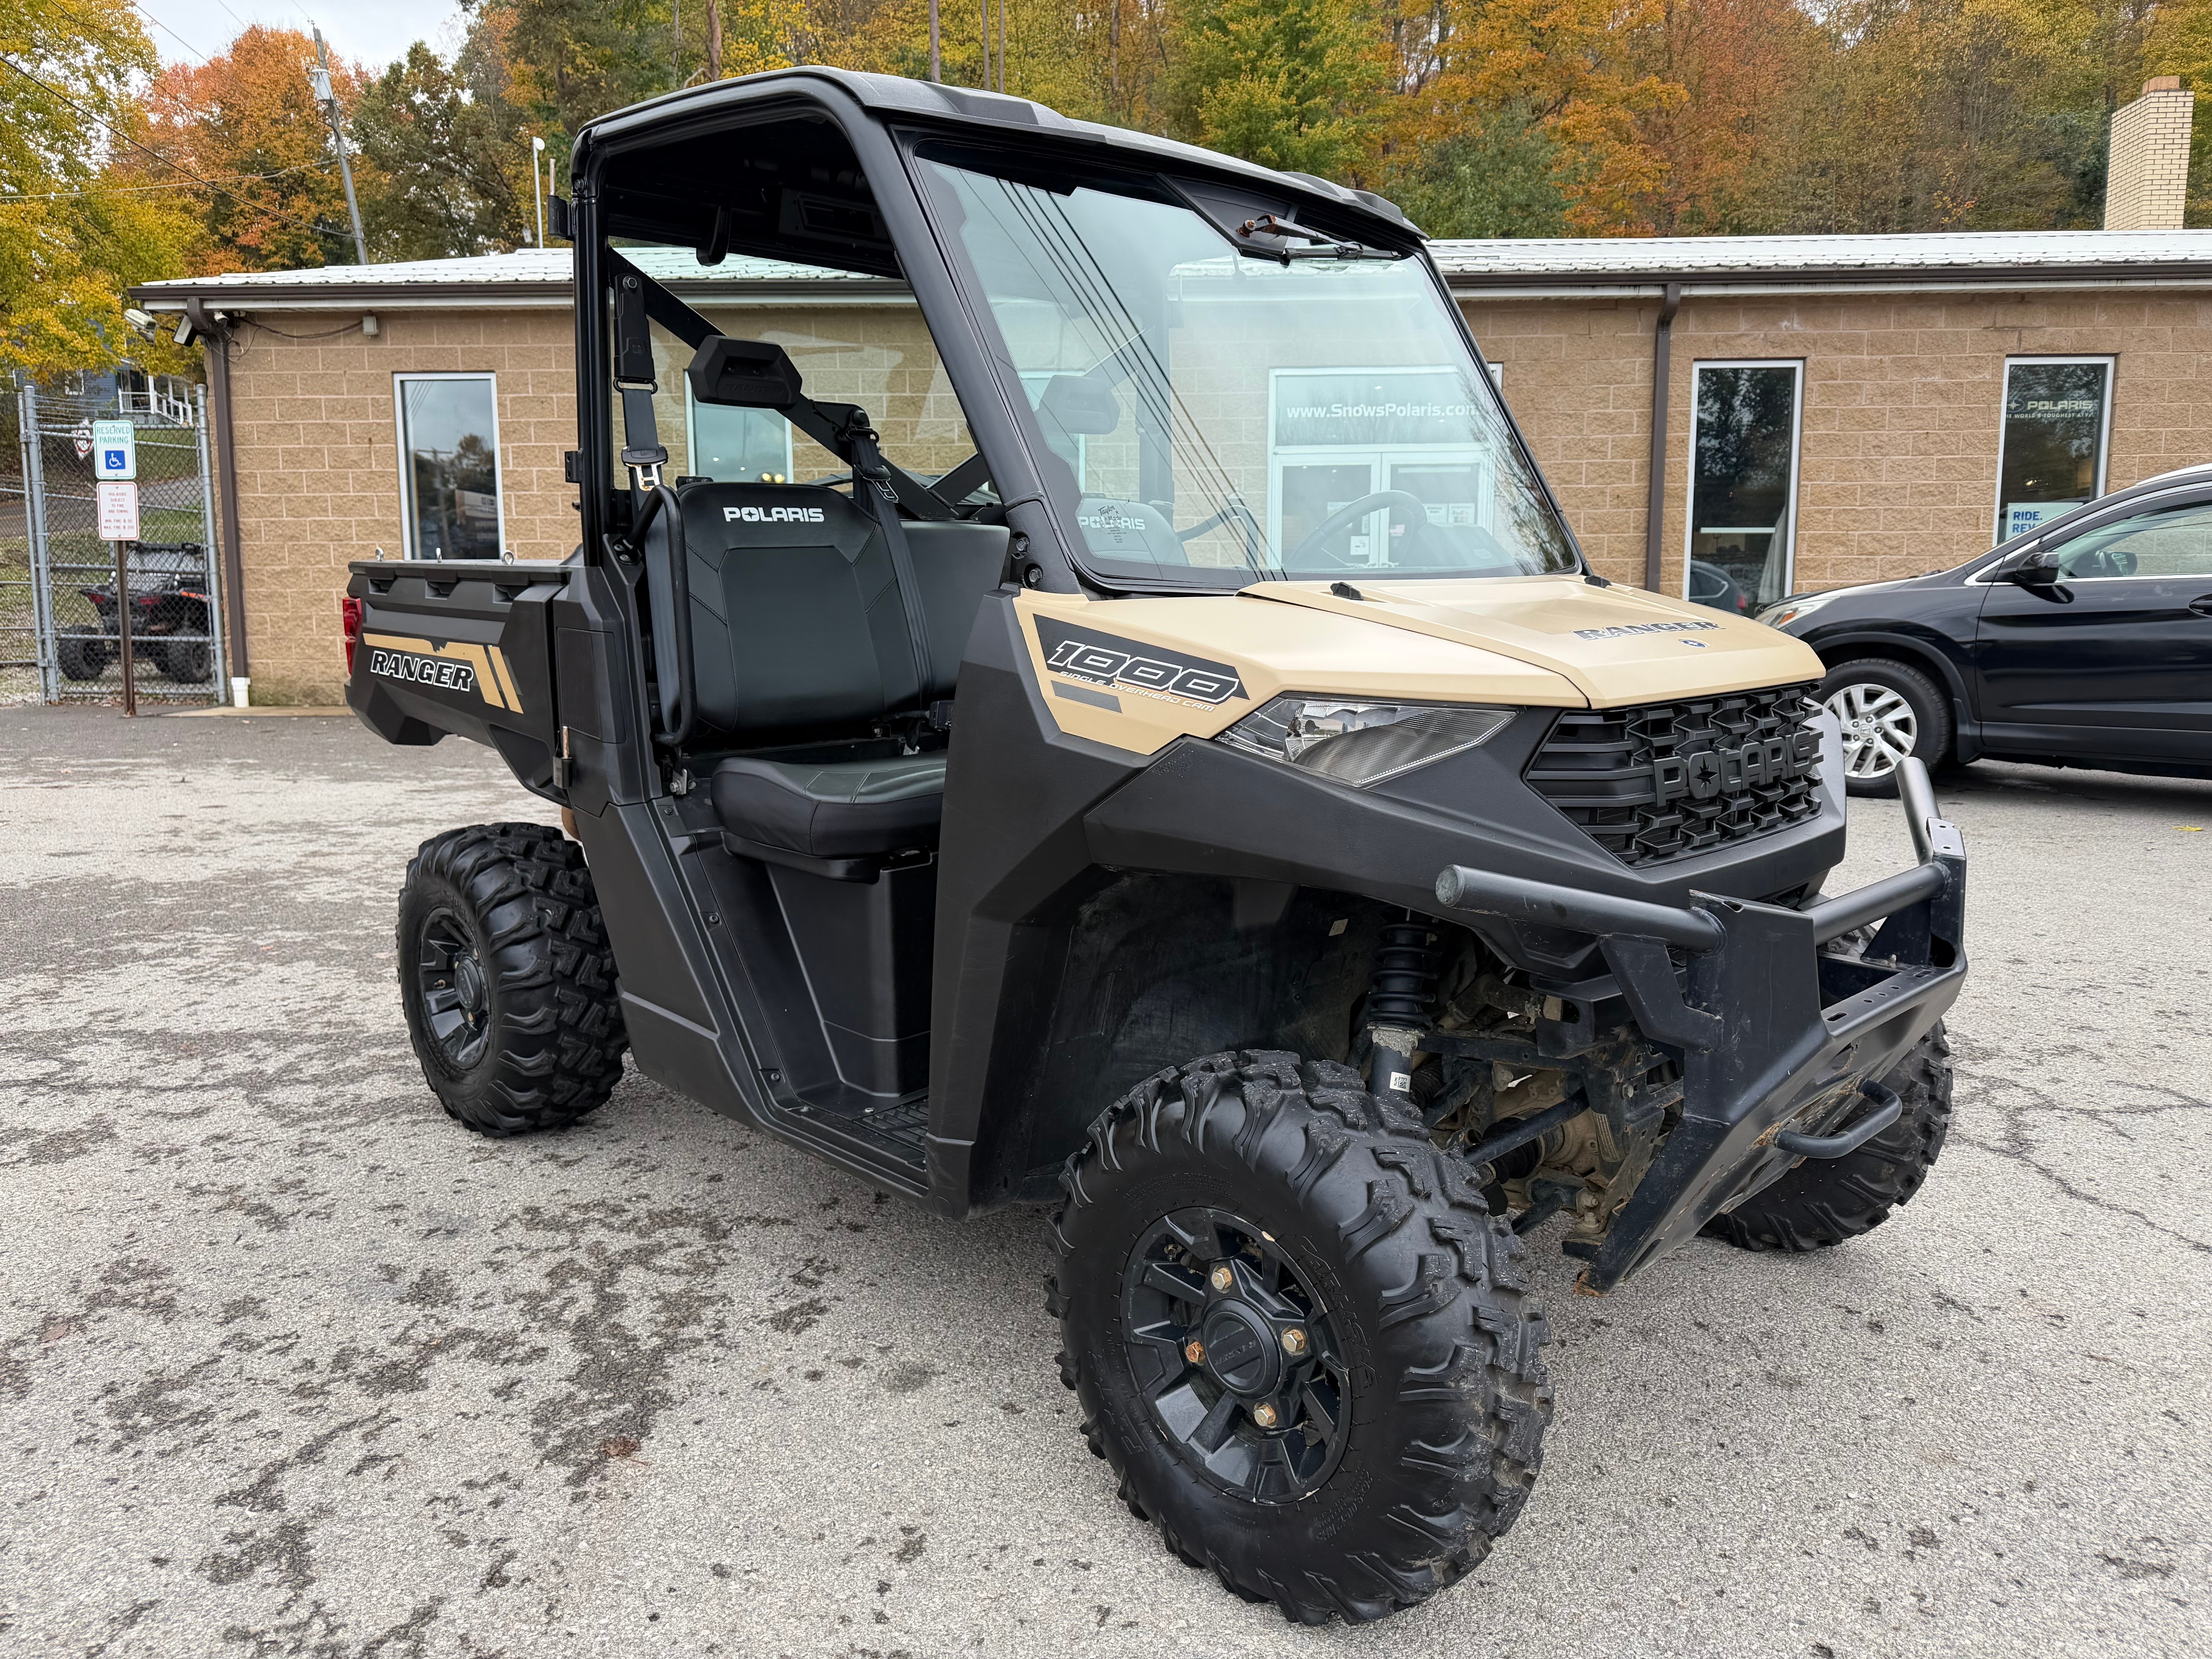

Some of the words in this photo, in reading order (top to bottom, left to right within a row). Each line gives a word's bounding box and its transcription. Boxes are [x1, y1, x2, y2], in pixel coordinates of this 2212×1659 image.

[1287, 402, 1479, 417] www.SnowsPolaris.com
[2027, 400, 2093, 410] POLARIS
[723, 507, 824, 522] POLARIS
[1098, 505, 1116, 516] Taylor
[2013, 511, 2043, 521] RIDE.
[1570, 621, 1726, 641] RANGER
[371, 650, 474, 692] RANGER
[1047, 640, 1239, 703] 1000
[1058, 670, 1107, 686] SINGLE
[1108, 683, 1182, 704] OVERHEAD
[1182, 699, 1216, 712] CAM
[1652, 729, 1815, 807] POLARIS
